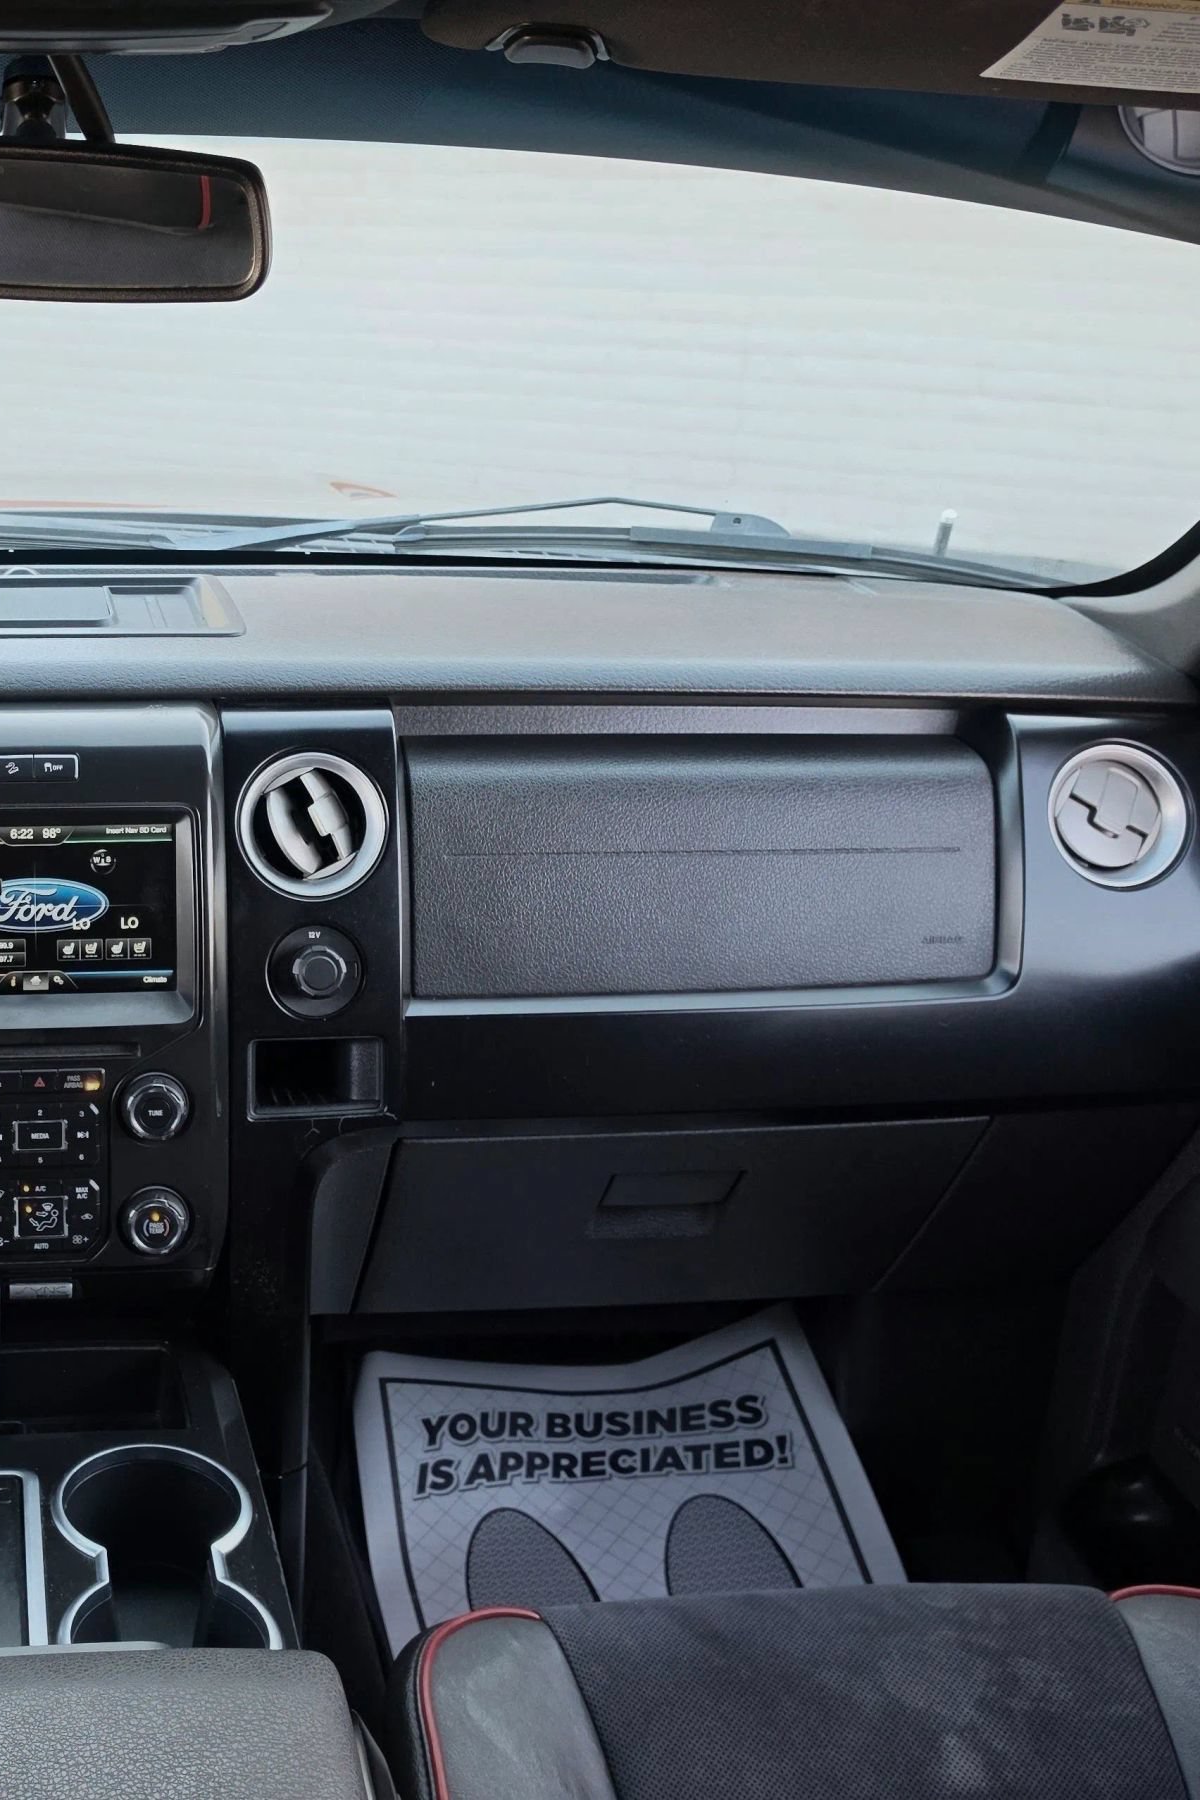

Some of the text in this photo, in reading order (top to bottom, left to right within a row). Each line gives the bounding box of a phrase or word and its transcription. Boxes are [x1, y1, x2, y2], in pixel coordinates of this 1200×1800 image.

[9, 828, 34, 840] 6:22
[125, 827, 139, 835] Nav
[150, 826, 167, 834] Card
[72, 918, 91, 931] LO
[120, 916, 139, 930] LO
[142, 976, 168, 984] Climate
[37, 1109, 43, 1117] 2
[147, 1109, 164, 1117] TUNE
[30, 1132, 50, 1140] MEDIA
[33, 1242, 50, 1250] AUTO
[421, 1395, 764, 1447] YOUR BUSINESS
[416, 1436, 789, 1495] IS APPRECIATED!
